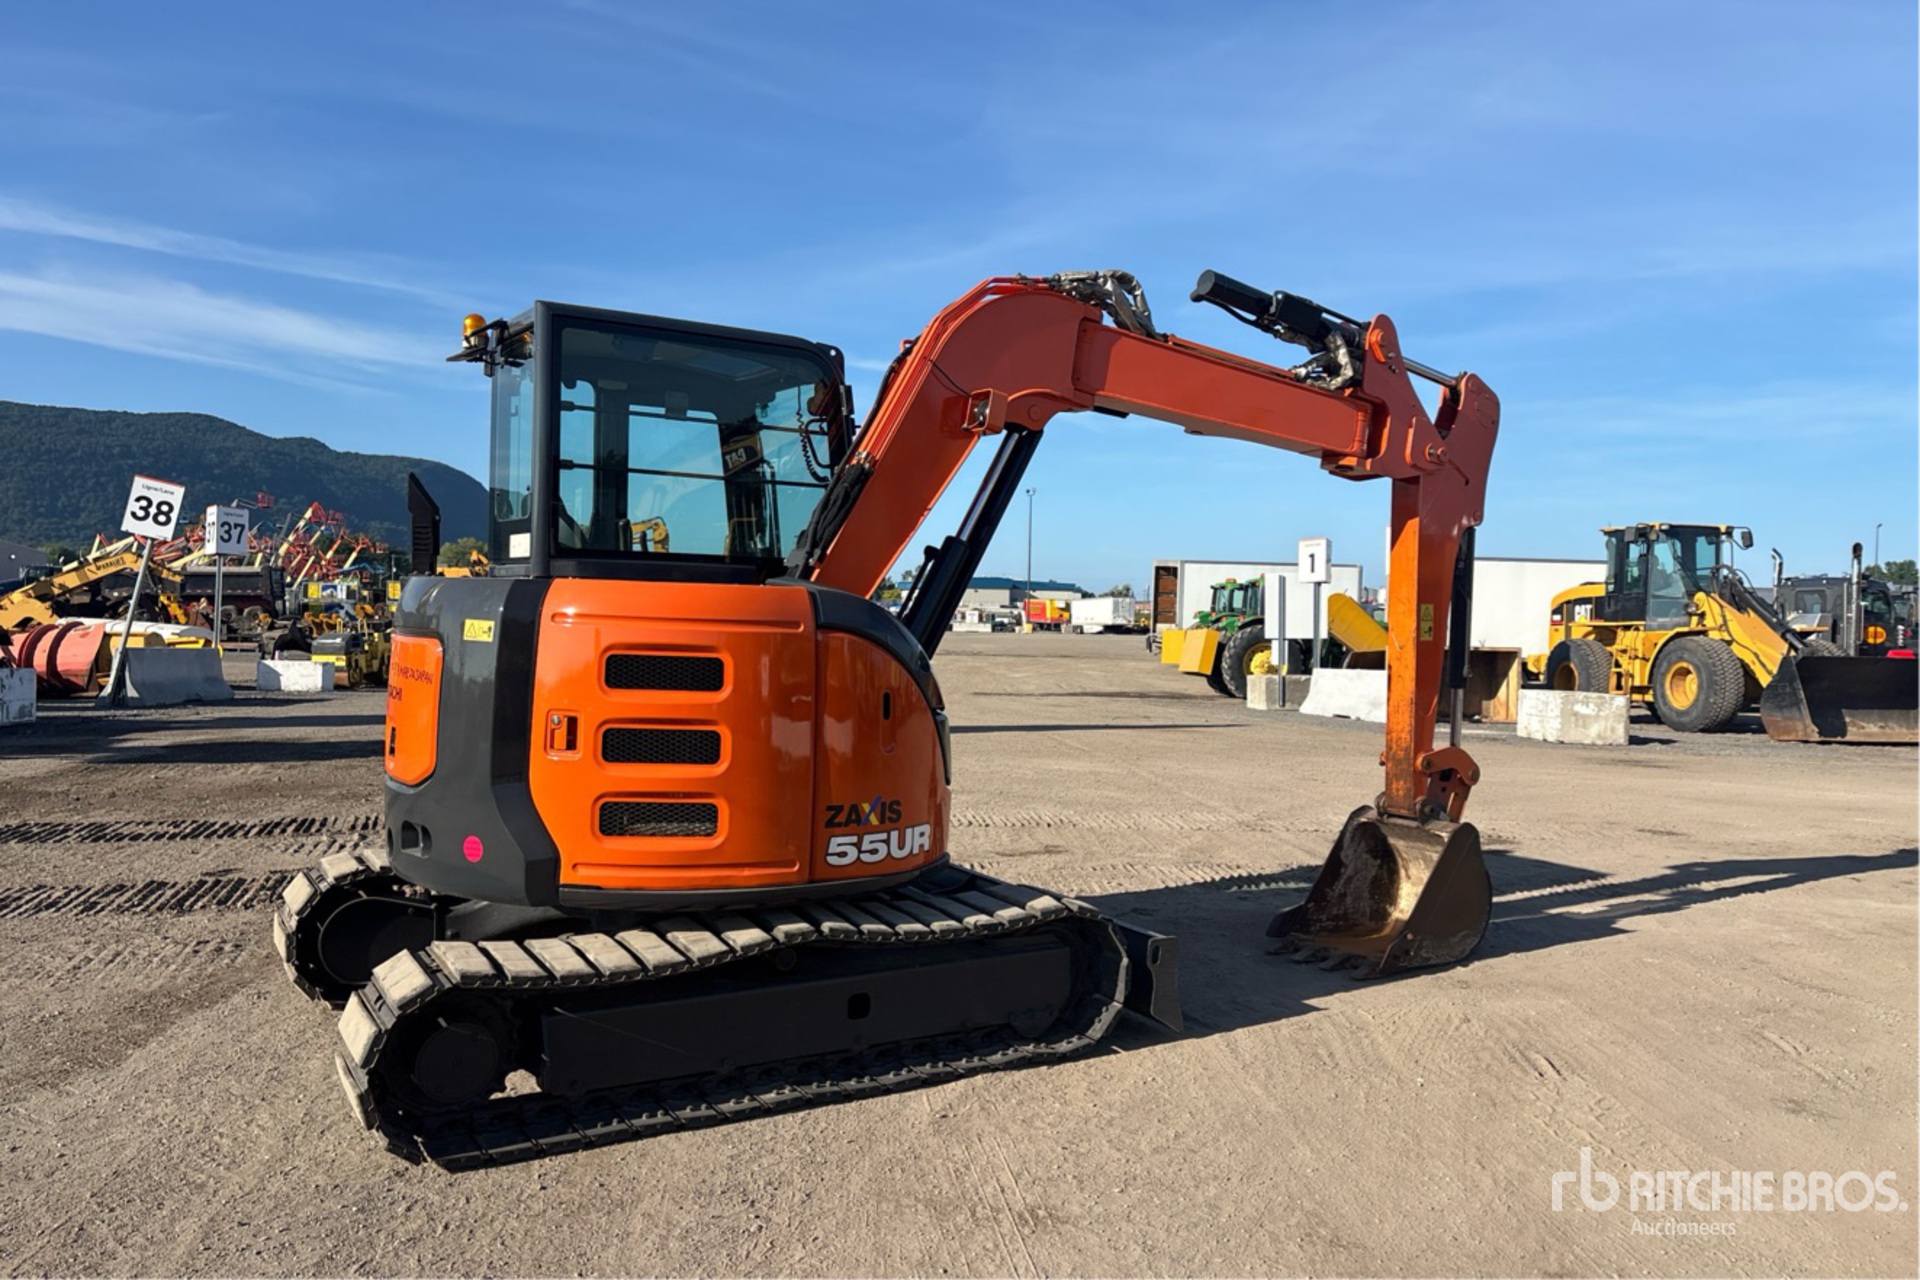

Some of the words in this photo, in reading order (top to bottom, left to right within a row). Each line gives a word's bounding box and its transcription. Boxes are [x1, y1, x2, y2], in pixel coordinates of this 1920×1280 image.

[130, 495, 175, 527] 38
[220, 520, 246, 545] 37
[1308, 552, 1315, 574] 1
[824, 795, 903, 829] ZAXIS
[825, 823, 931, 867] 55UR
